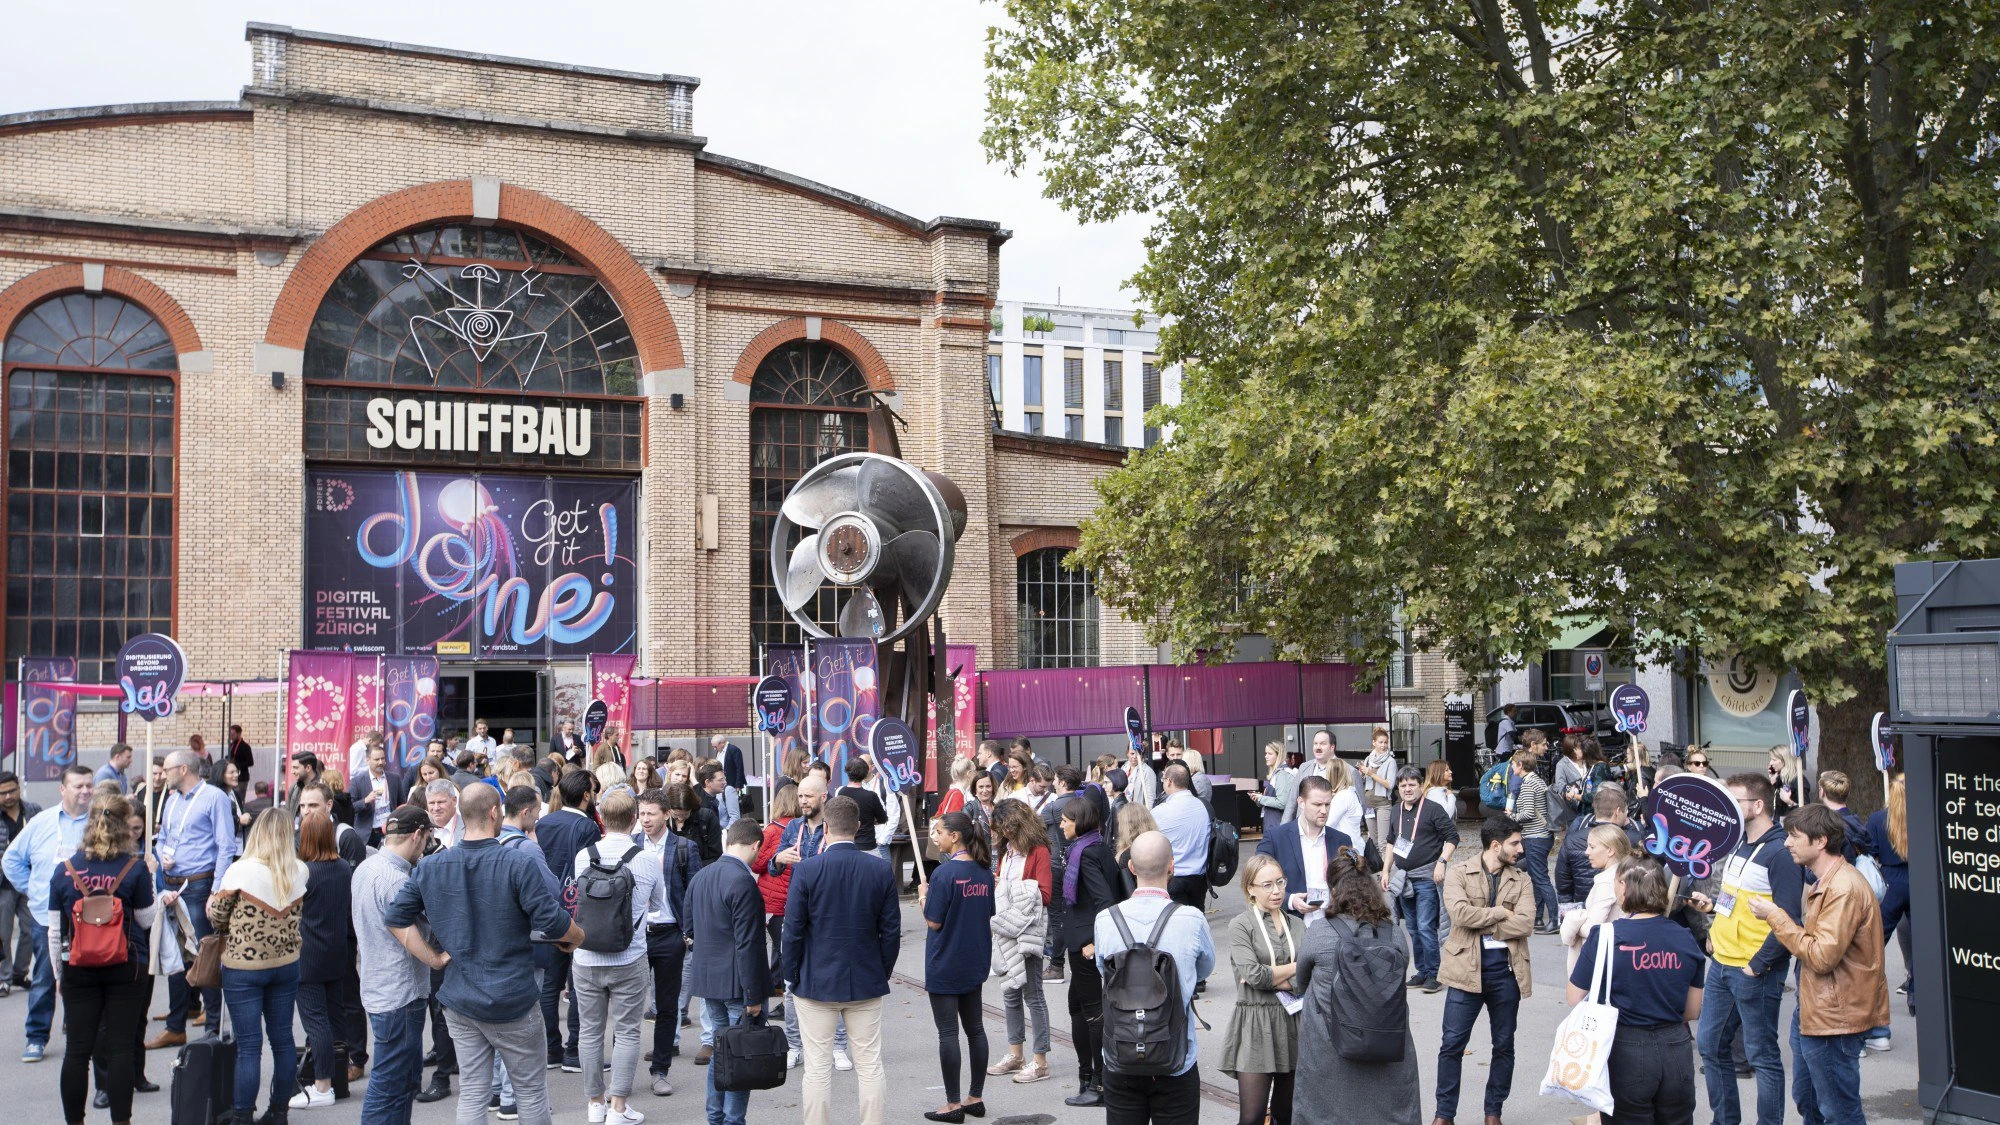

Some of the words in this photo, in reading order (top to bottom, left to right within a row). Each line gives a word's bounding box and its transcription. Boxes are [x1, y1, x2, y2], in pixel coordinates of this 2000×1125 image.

[366, 397, 591, 456] SCHIFFBAU
[522, 499, 588, 566] Get
[562, 540, 581, 566] it
[316, 590, 380, 604] DIGITAL
[316, 606, 391, 620] FESTIVAL
[315, 620, 377, 635] ZÜRICH
[353, 644, 385, 652] swisscom
[492, 643, 518, 651] randstad
[1444, 701, 1472, 711] Schiffbau
[1721, 695, 1764, 712] childcare
[292, 742, 339, 752] DIGITAL
[1945, 773, 1967, 790] At
[1657, 788, 1677, 800] DOES
[1678, 796, 1700, 810] AGILE
[1701, 806, 1737, 825] WORKING
[1664, 798, 1680, 808] KILL
[1681, 804, 1726, 828] CORPORATE
[1945, 797, 1966, 815] of
[1946, 822, 1979, 841] the
[1947, 845, 2000, 872] lenge
[65, 867, 117, 892] Team
[955, 877, 989, 898] Team
[1619, 941, 1682, 970] Team
